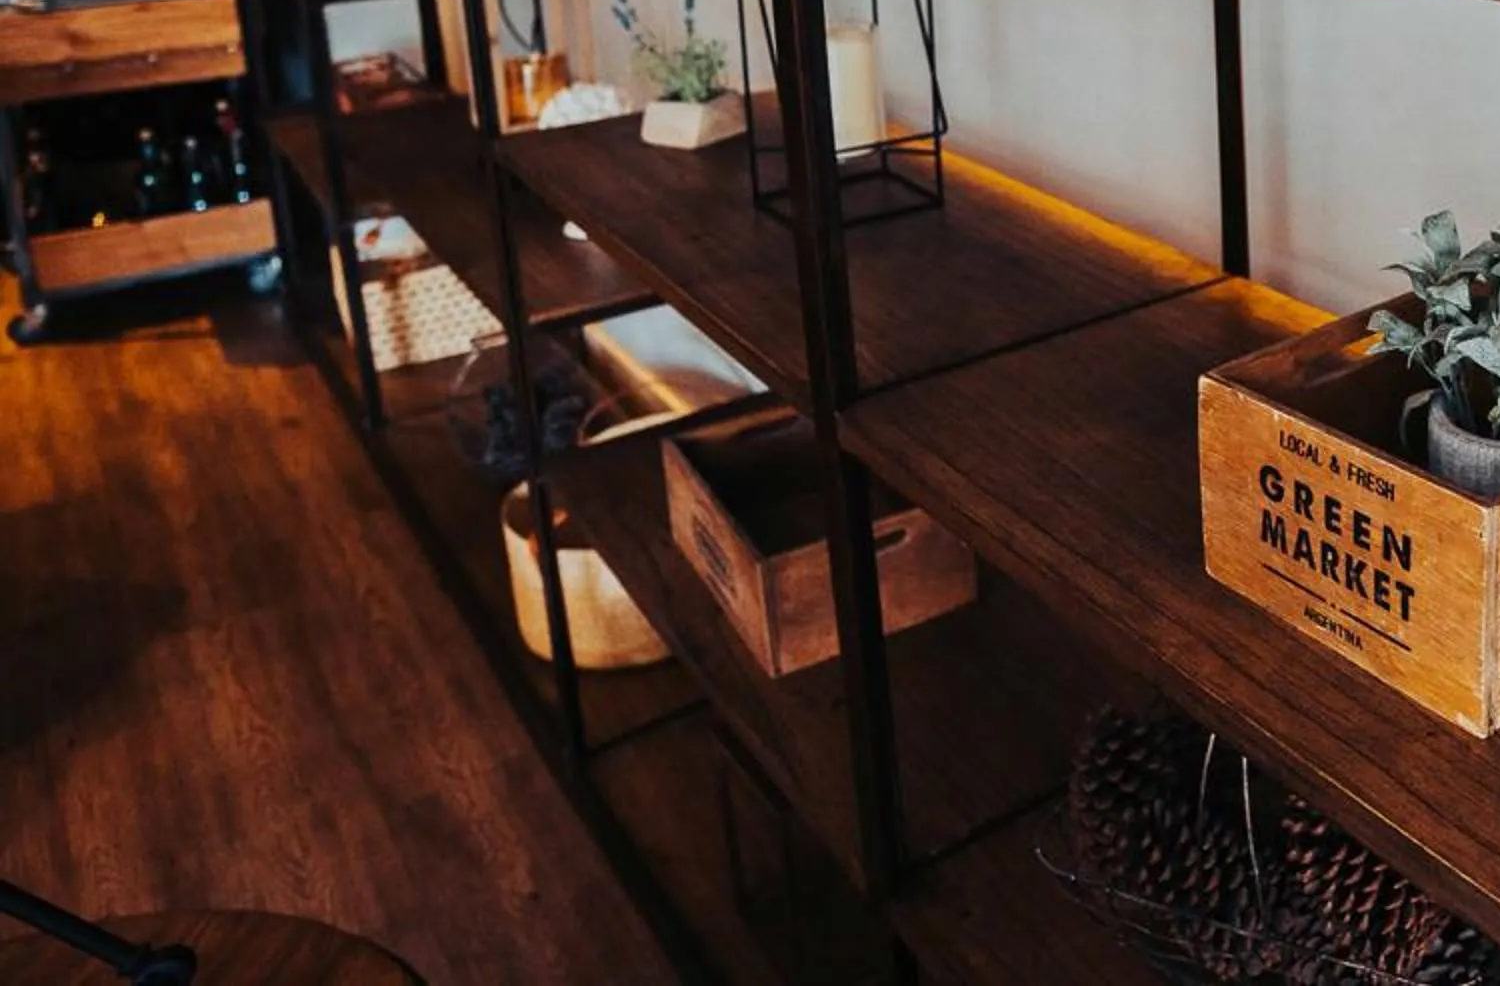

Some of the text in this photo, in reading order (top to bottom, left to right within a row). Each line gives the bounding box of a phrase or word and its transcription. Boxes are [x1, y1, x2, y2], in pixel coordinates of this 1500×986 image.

[1259, 465, 1412, 572] GREEN
[1279, 430, 1397, 502] LOCAL & FRESH
[1260, 509, 1416, 622] MARKET
